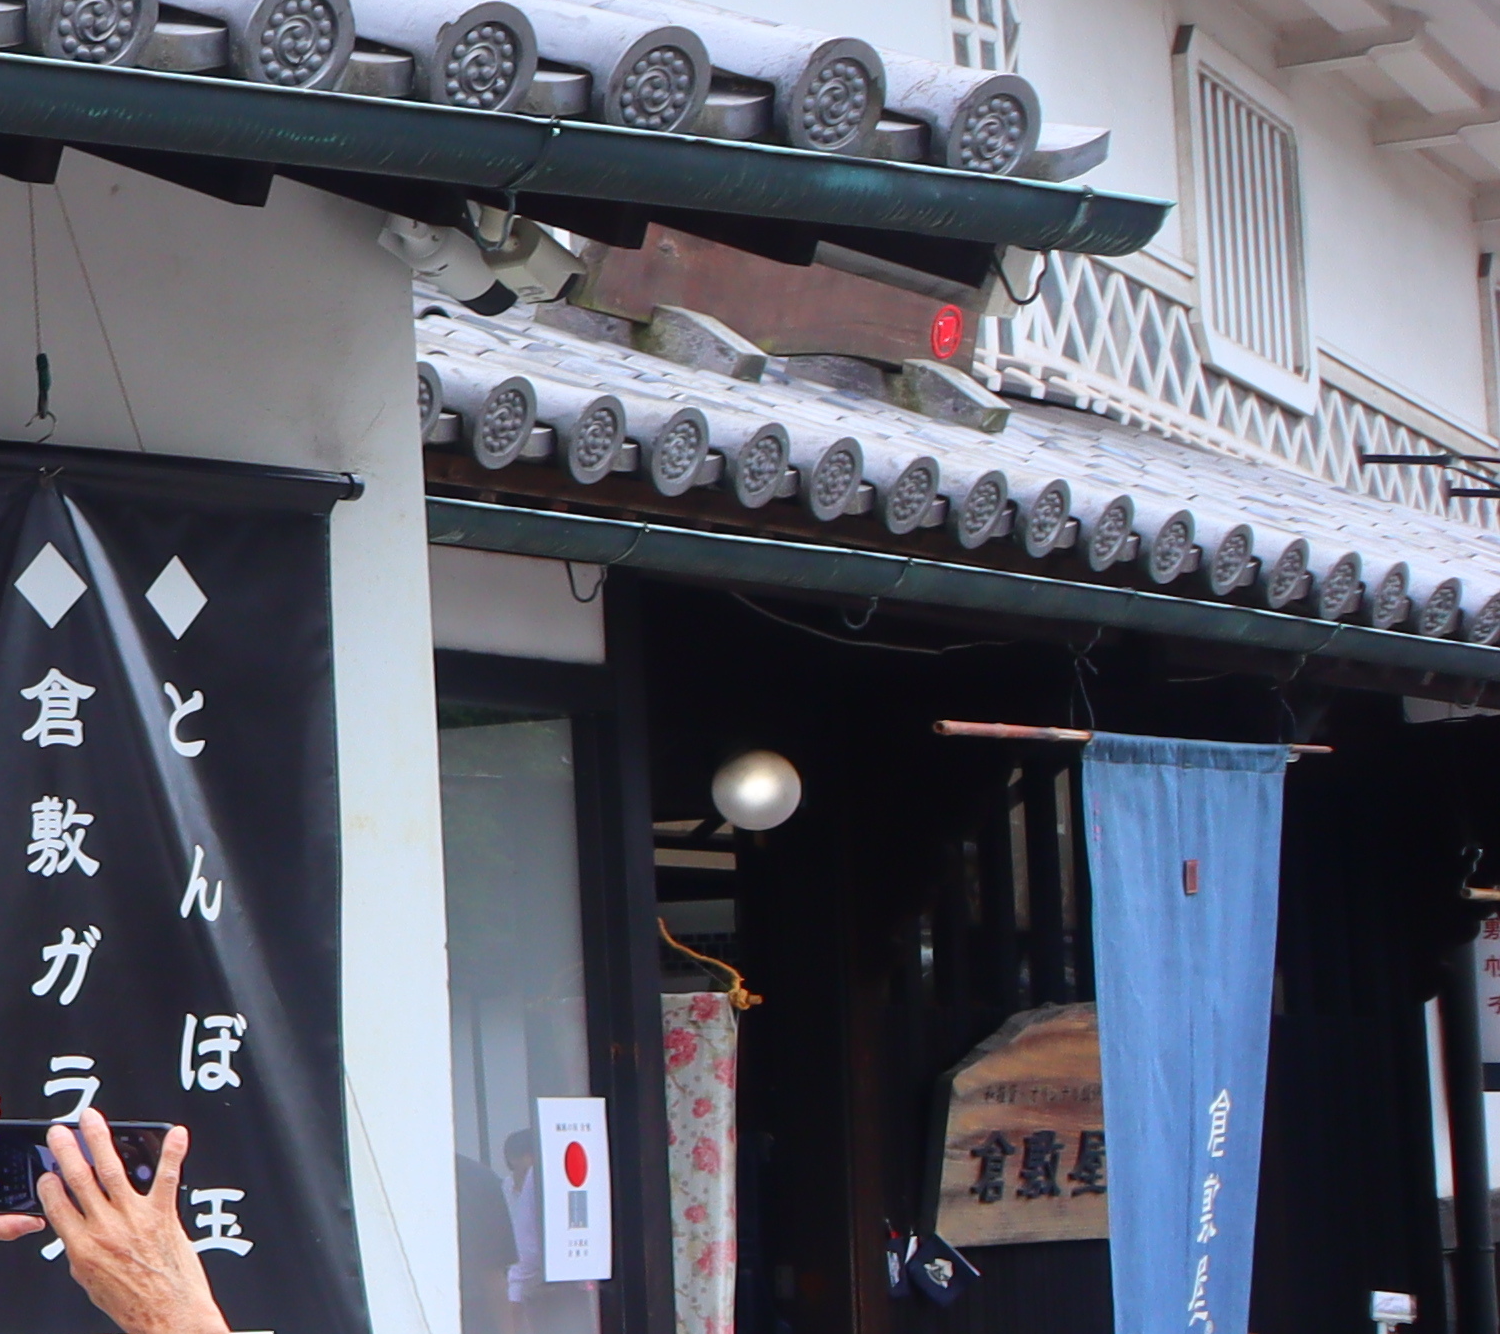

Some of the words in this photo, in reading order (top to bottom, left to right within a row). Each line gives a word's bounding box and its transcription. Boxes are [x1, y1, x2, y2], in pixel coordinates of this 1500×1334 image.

[20, 667, 104, 1261] 倉敷ガラ
[166, 679, 254, 1258] とんぼ玉
